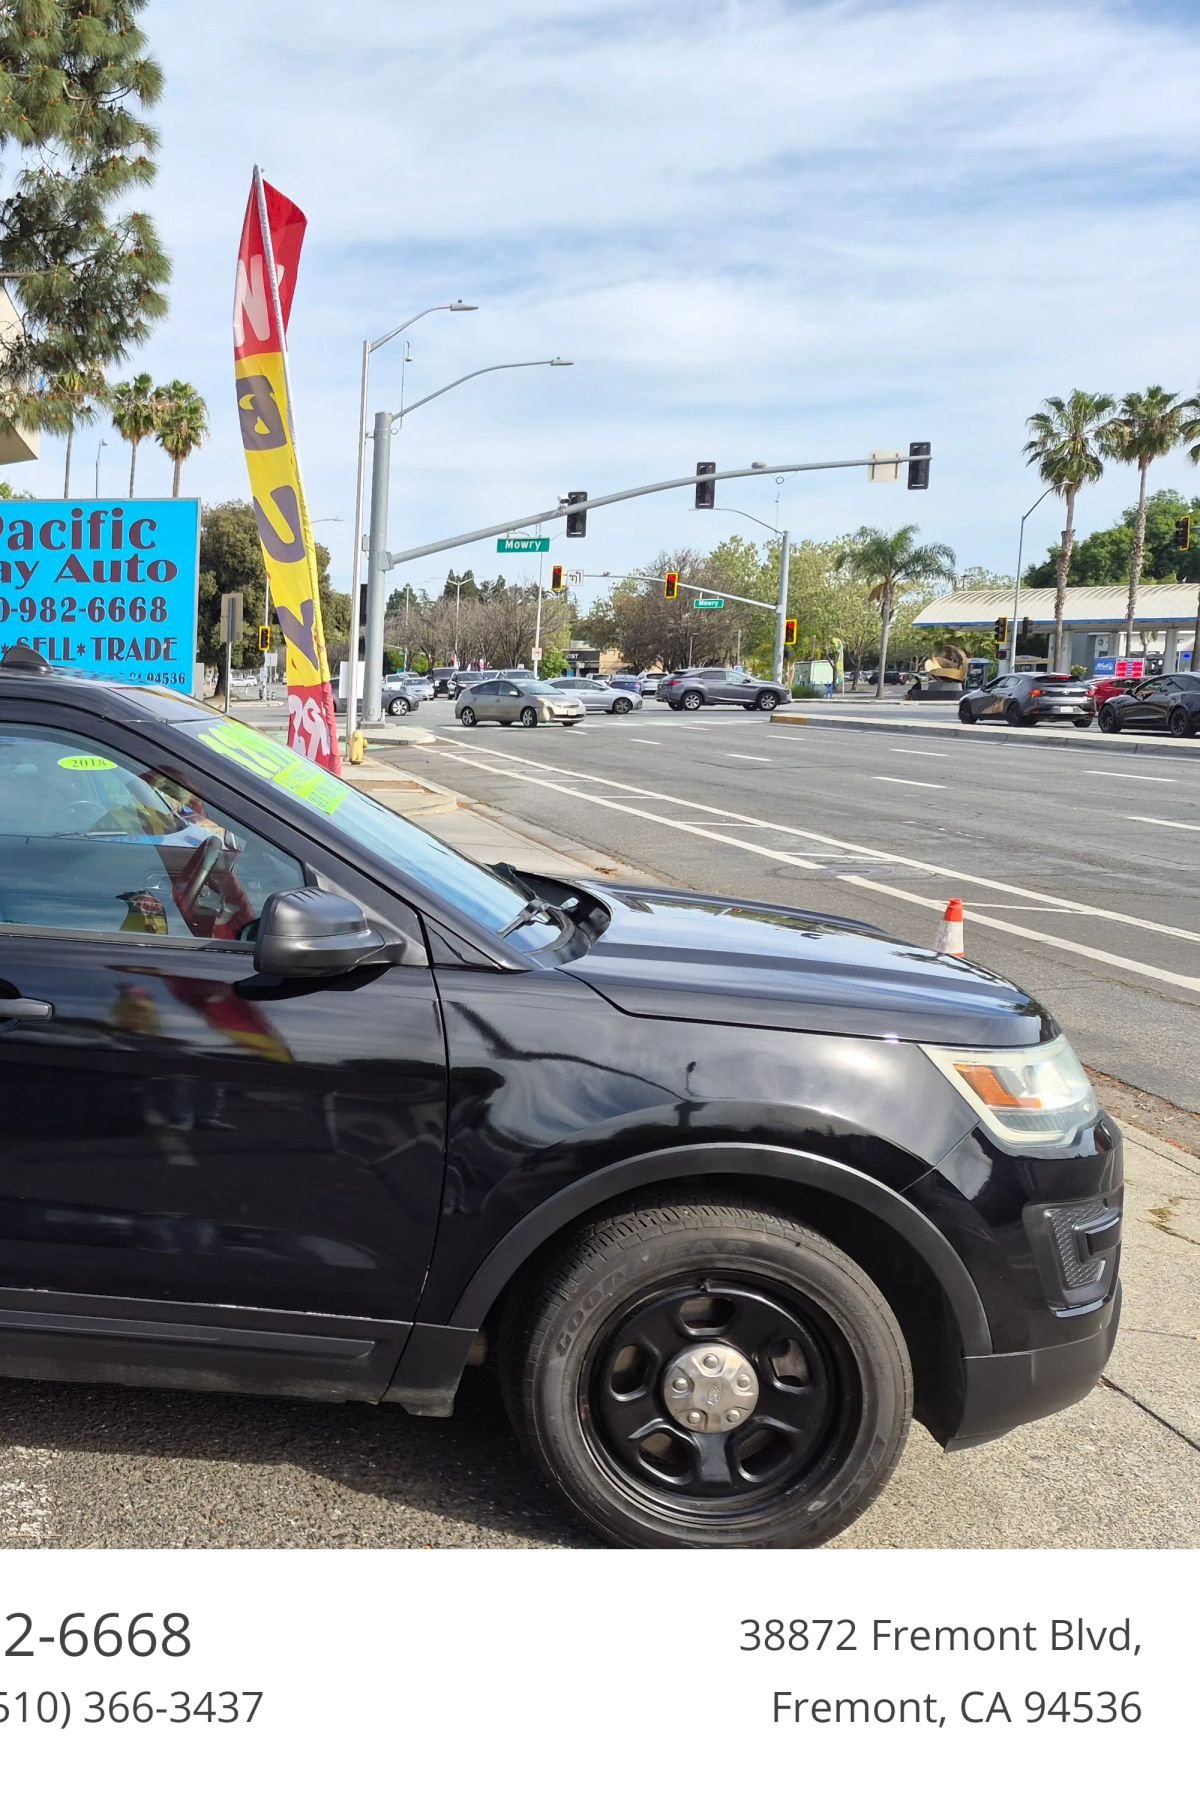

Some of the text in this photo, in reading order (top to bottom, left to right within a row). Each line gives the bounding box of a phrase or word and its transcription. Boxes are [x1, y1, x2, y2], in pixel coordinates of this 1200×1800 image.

[505, 540, 541, 551] Mowry
[54, 553, 178, 583] Auto
[90, 637, 177, 661] TRADE
[72, 759, 106, 767] 2018
